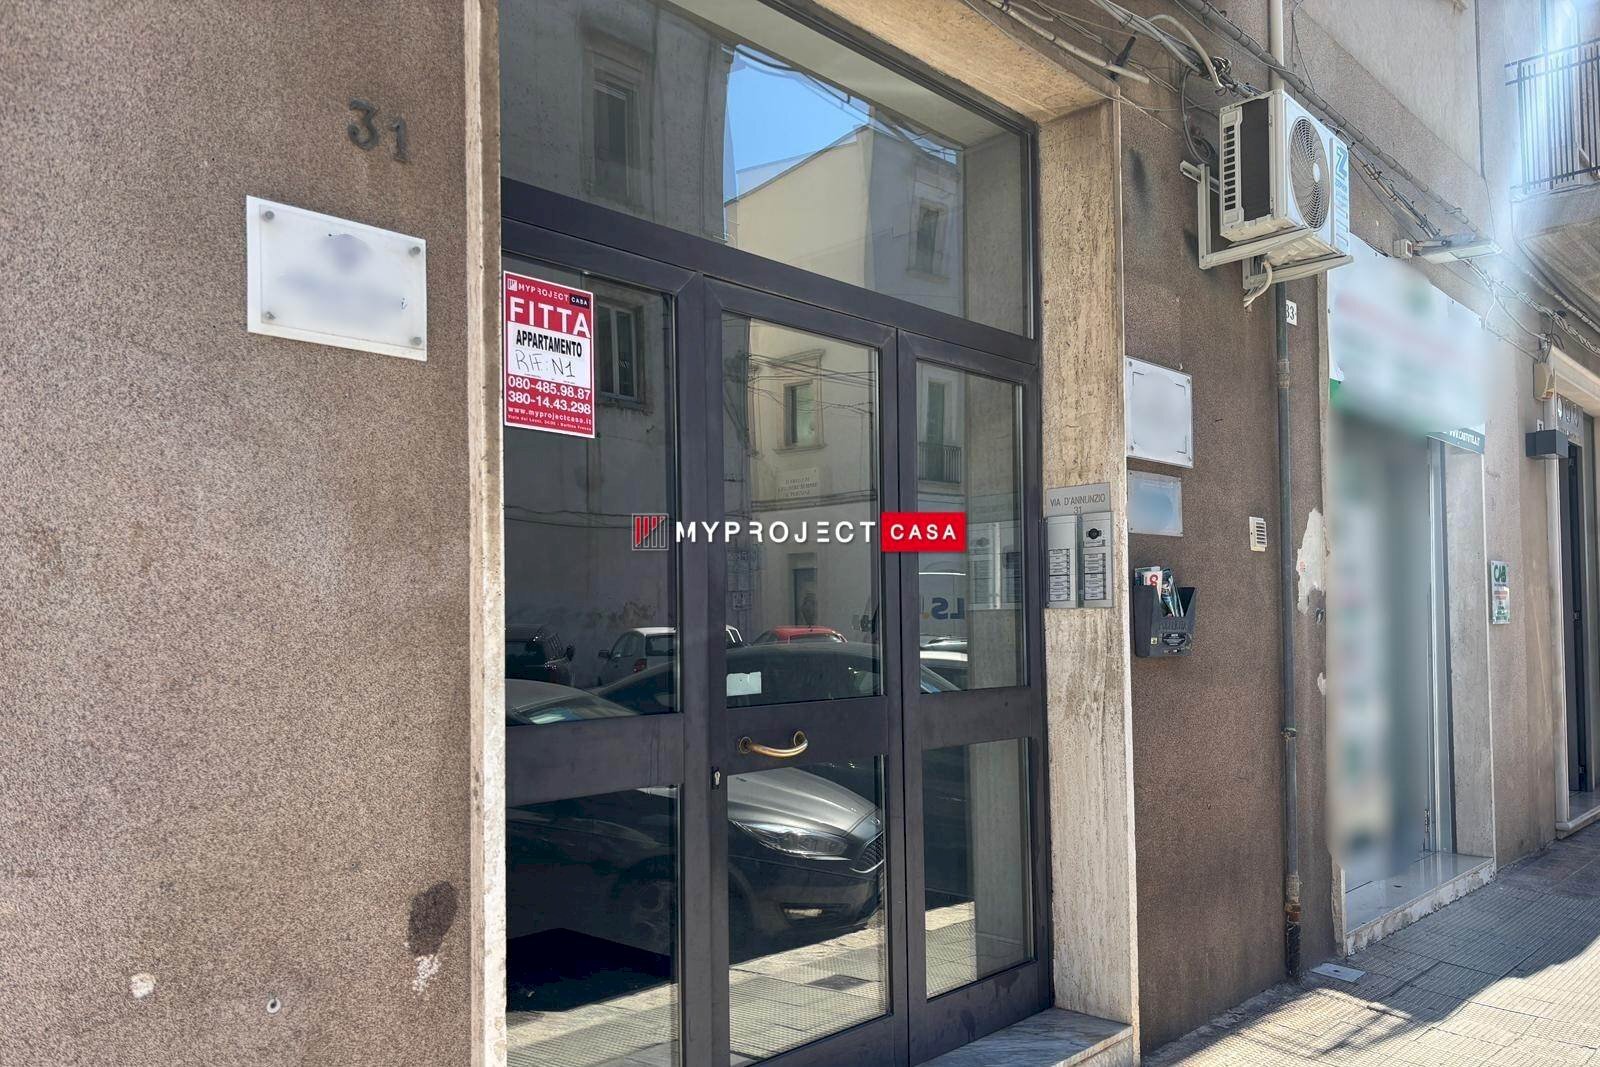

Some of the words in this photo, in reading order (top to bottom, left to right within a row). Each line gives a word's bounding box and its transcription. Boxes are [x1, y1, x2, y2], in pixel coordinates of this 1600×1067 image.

[347, 98, 411, 163] 31
[518, 282, 570, 303] MYPROJECT
[571, 297, 588, 306] CASA
[510, 296, 591, 339] FITTA
[516, 329, 583, 358] APPARTAMENTO
[508, 375, 591, 401] 080-485.98.87
[508, 390, 592, 415] 380-14.43.298
[508, 406, 592, 426] www.myprojectcasa.it
[1050, 497, 1061, 507] VIA
[1064, 493, 1106, 506] D'ANNUNZIO
[1073, 506, 1082, 515] 31
